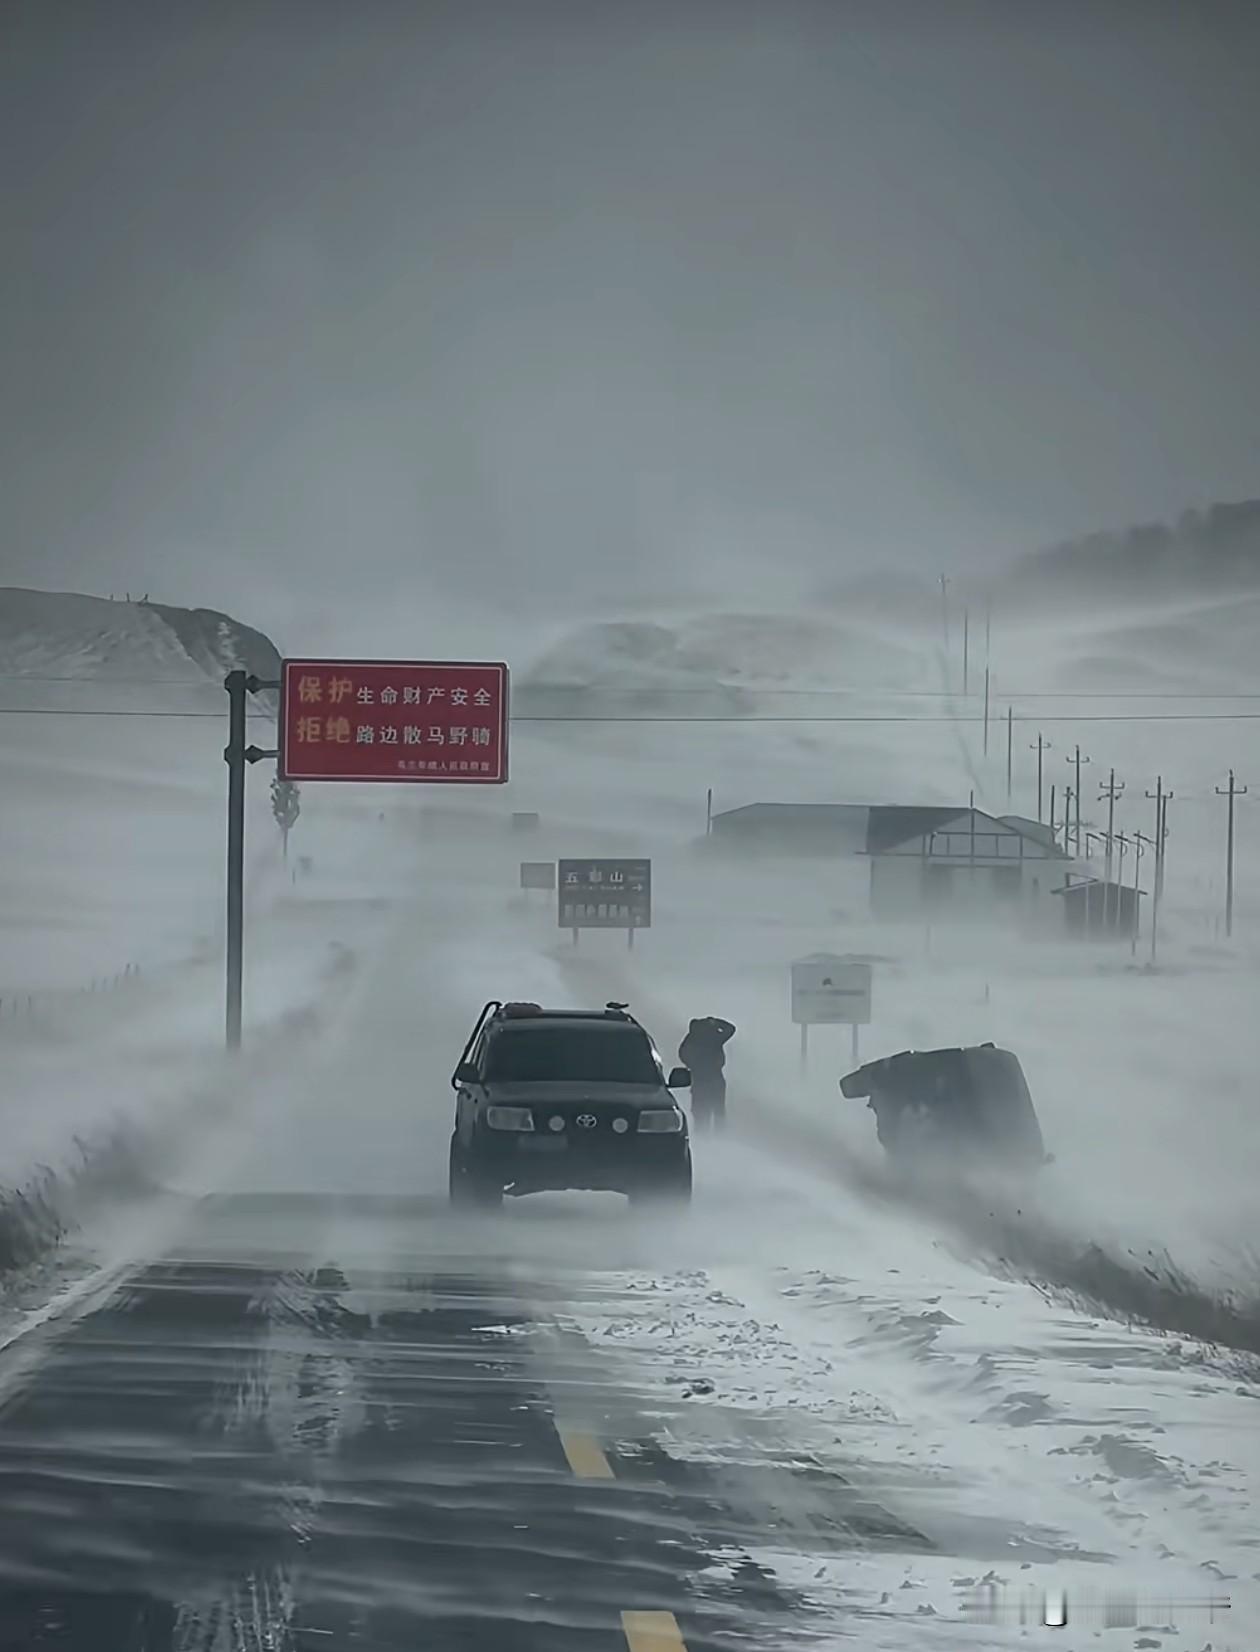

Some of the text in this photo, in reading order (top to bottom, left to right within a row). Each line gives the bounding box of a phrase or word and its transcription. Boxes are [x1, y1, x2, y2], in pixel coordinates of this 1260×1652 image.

[297, 675, 492, 706] 保护生命财产安全
